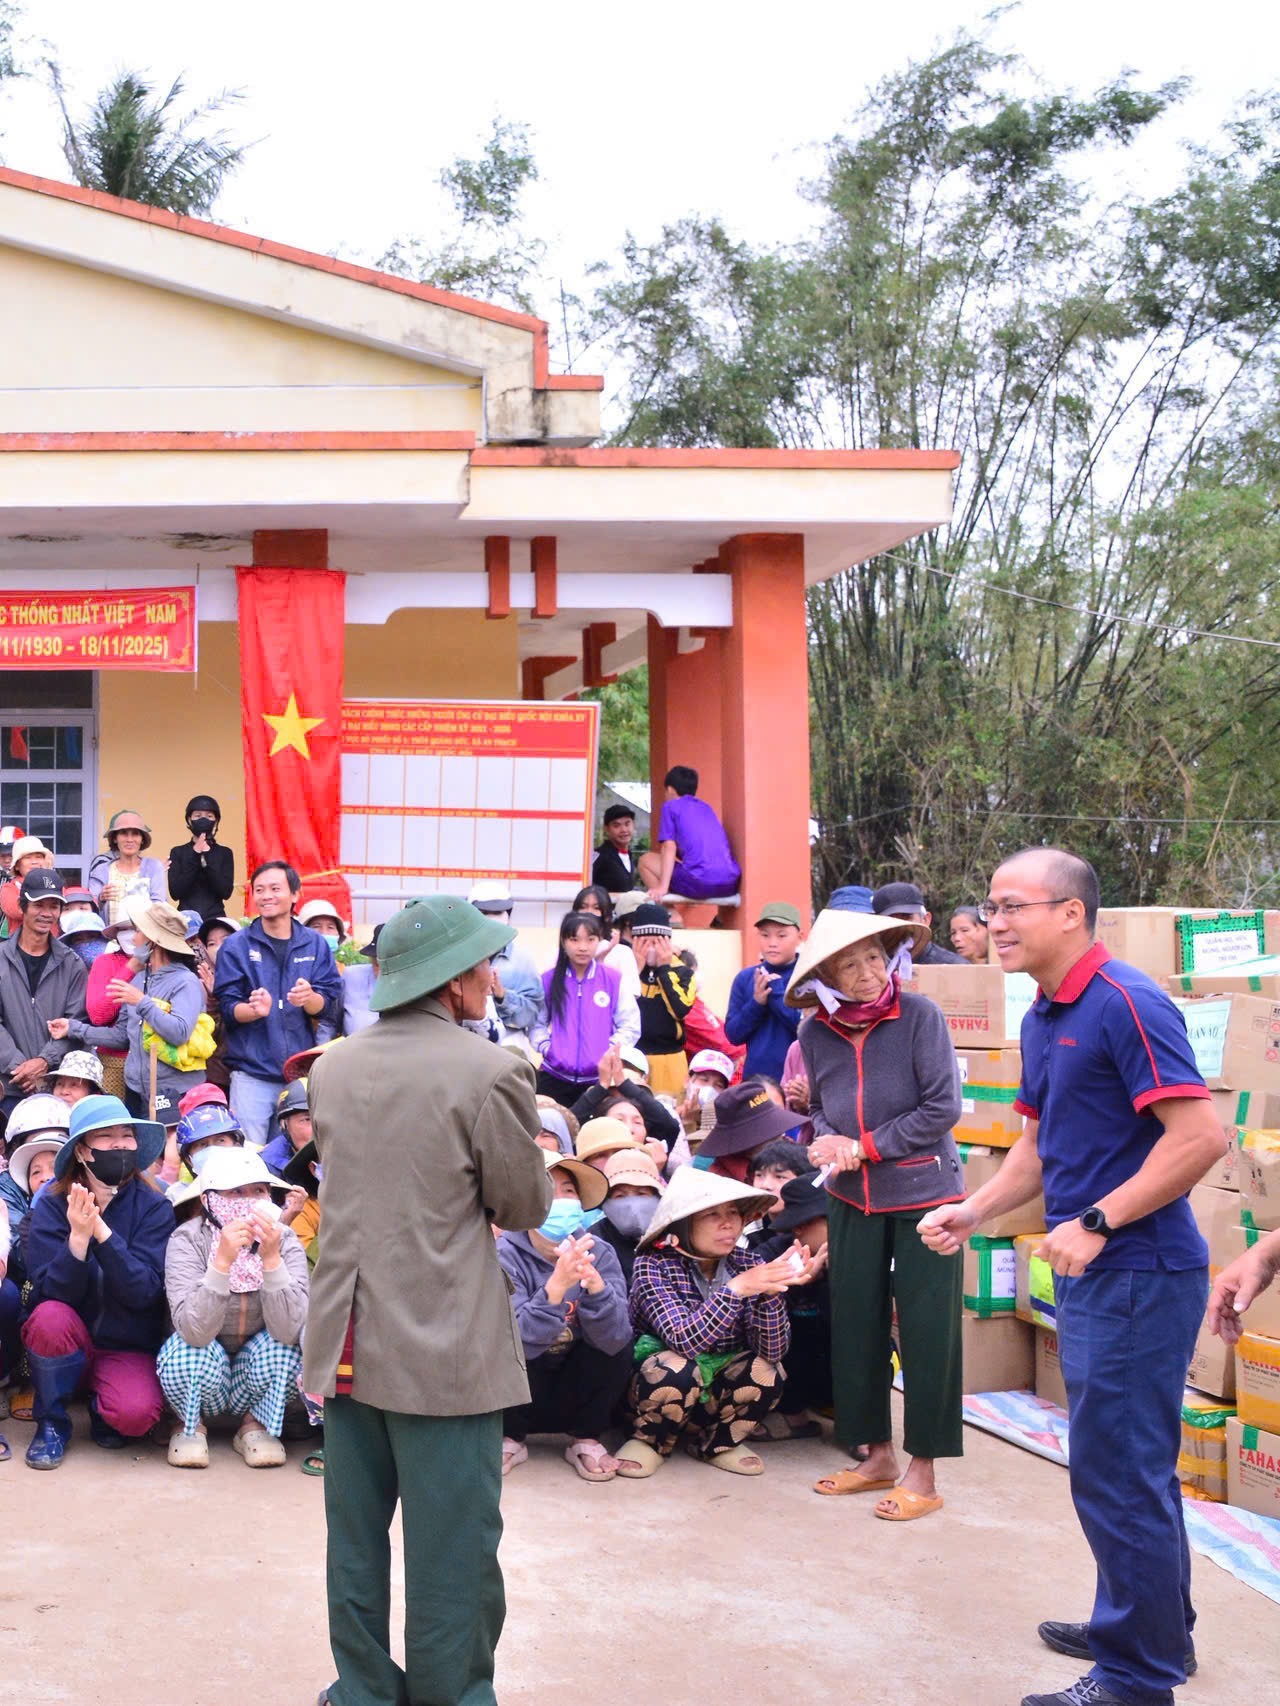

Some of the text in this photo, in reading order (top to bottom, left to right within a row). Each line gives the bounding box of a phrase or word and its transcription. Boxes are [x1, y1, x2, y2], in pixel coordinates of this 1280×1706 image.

[11, 599, 58, 625] THỐNG
[62, 598, 100, 625] NHẤT
[104, 600, 134, 629] VIỆT
[146, 604, 177, 624] NAM
[80, 635, 168, 660] 18/11/2025)
[946, 1017, 989, 1031] FAHAS
